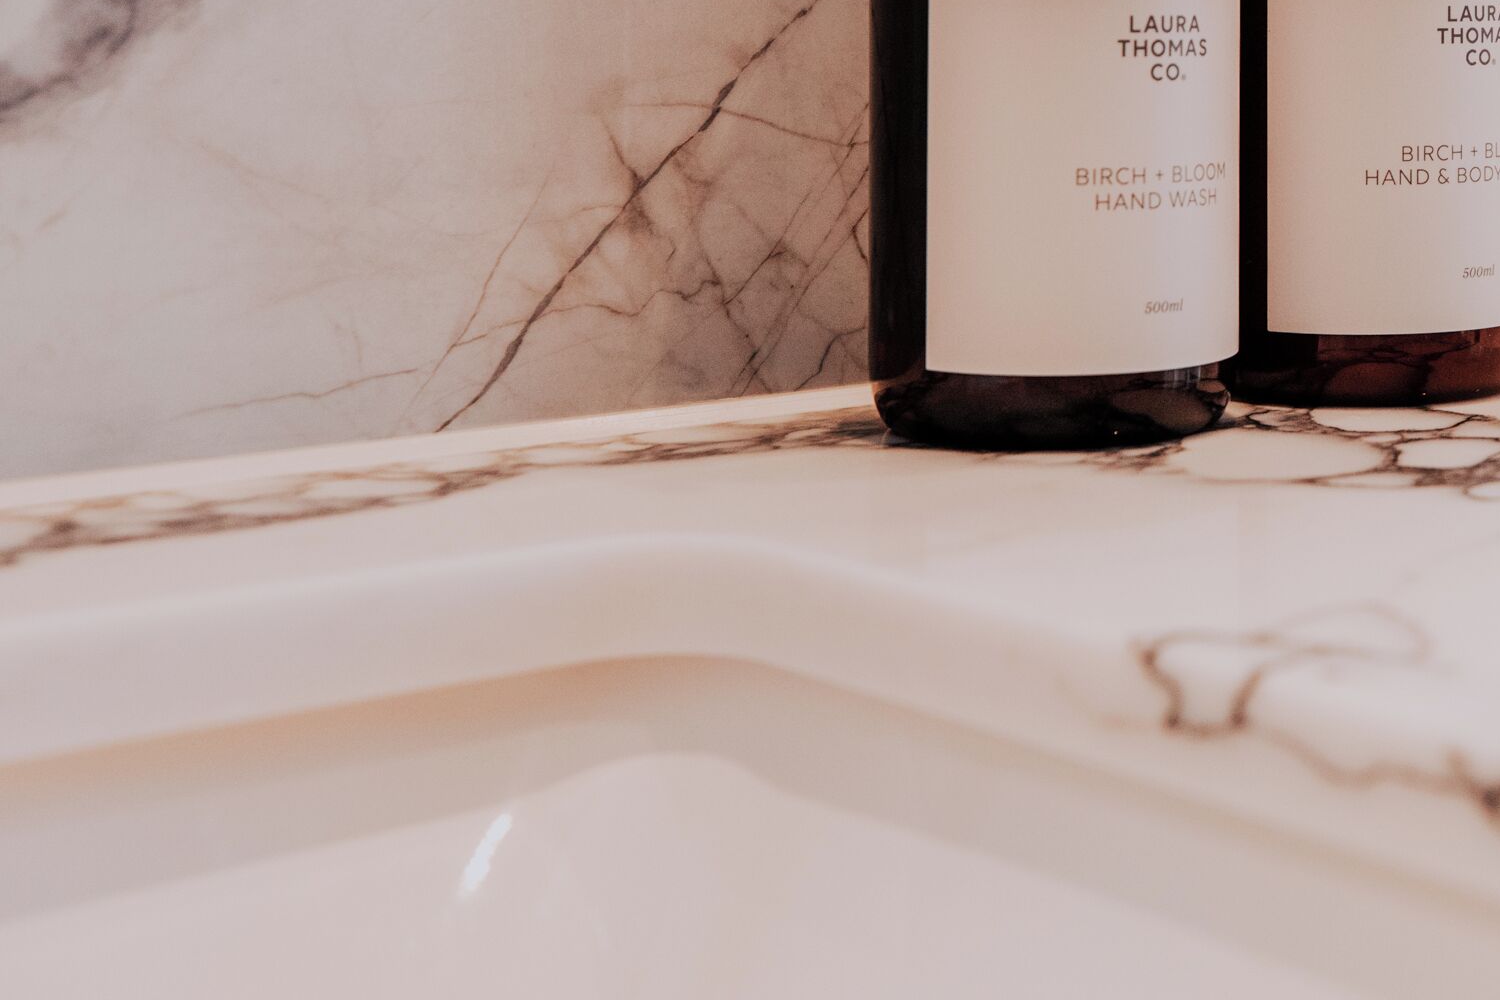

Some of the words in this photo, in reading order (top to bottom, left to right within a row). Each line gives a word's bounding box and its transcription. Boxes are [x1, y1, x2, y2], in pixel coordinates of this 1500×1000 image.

[1129, 15, 1200, 33] LAURA
[1117, 39, 1207, 57] THOMAS
[1401, 144, 1463, 162] BIRCH
[1470, 146, 1478, 157] +
[1075, 167, 1147, 186] BIRCH
[1155, 170, 1164, 181] +
[1172, 162, 1226, 183] BLOOM
[1365, 168, 1430, 186] HAND
[1437, 168, 1450, 185] &
[1095, 192, 1162, 211] HAND
[1168, 188, 1217, 208] WASH
[1462, 264, 1495, 279] 500ml
[1144, 298, 1184, 314] 500ml
